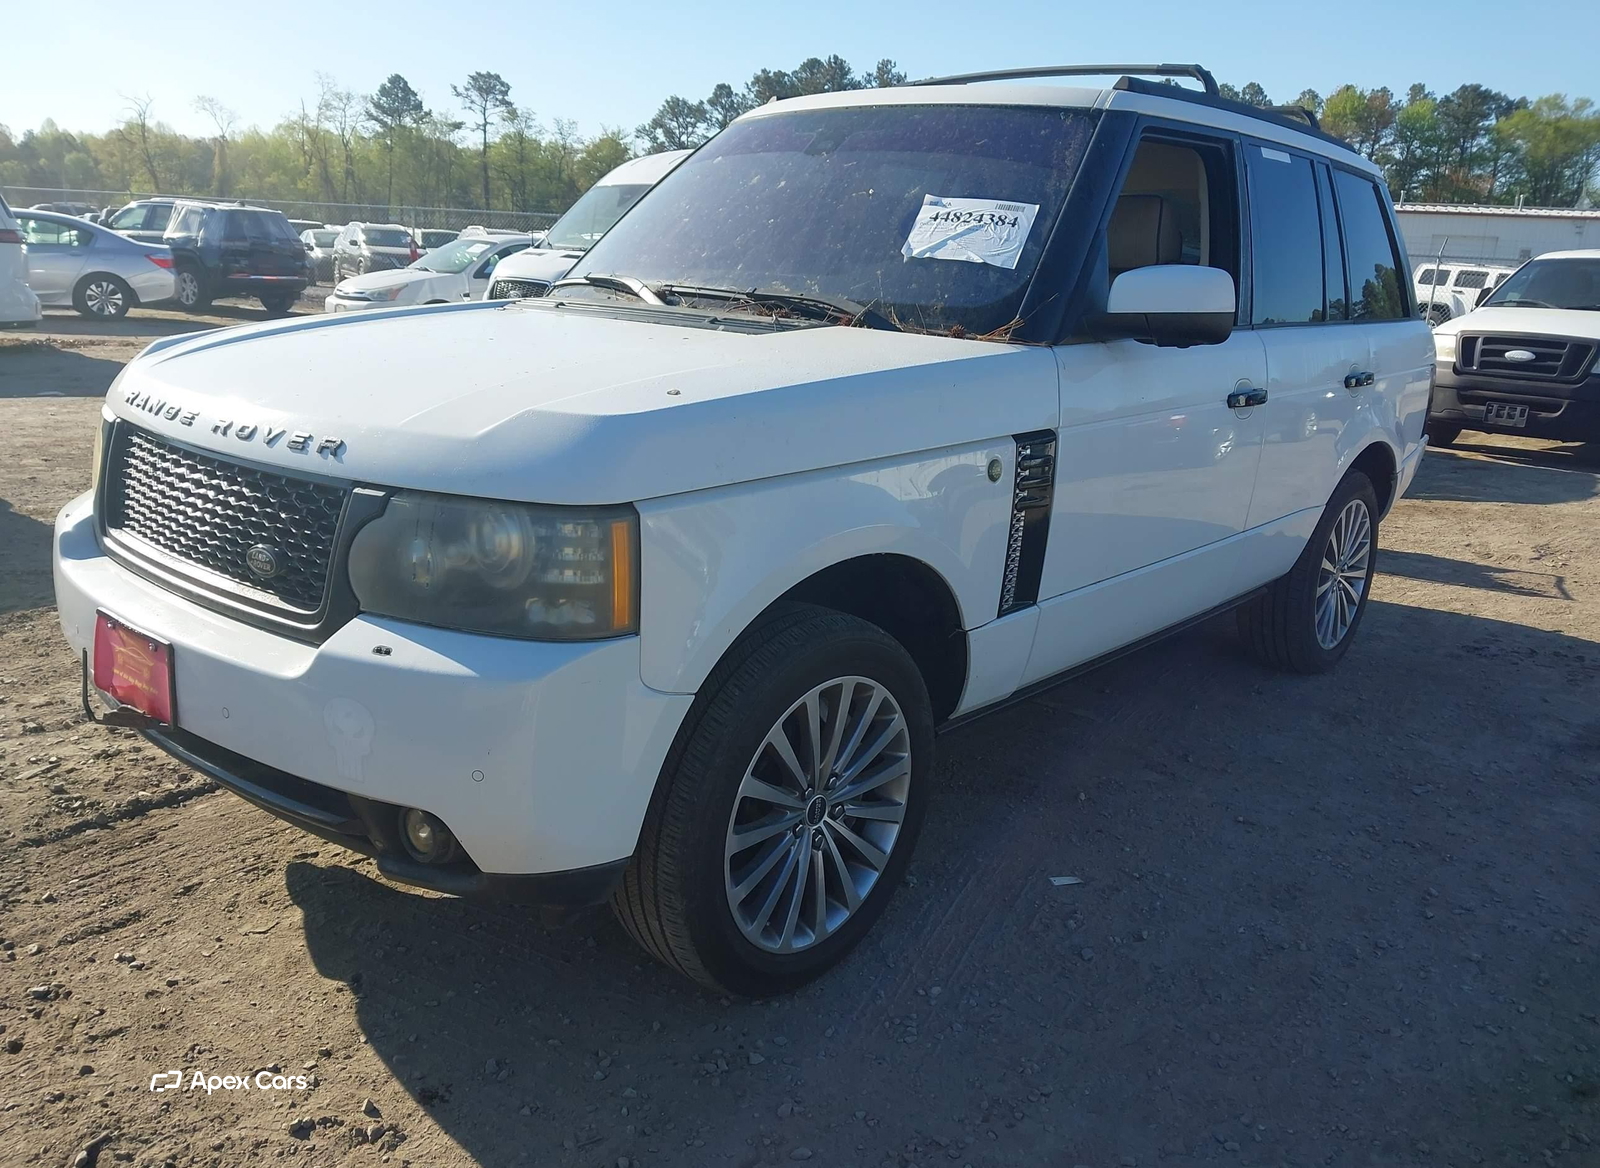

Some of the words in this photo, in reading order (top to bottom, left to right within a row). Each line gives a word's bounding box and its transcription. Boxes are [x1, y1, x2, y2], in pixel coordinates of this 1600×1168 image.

[929, 210, 1019, 228] 44824384
[125, 391, 200, 427] RANGE
[211, 419, 344, 458] ROVER
[252, 551, 266, 562] LAND
[253, 559, 271, 571] ROVER
